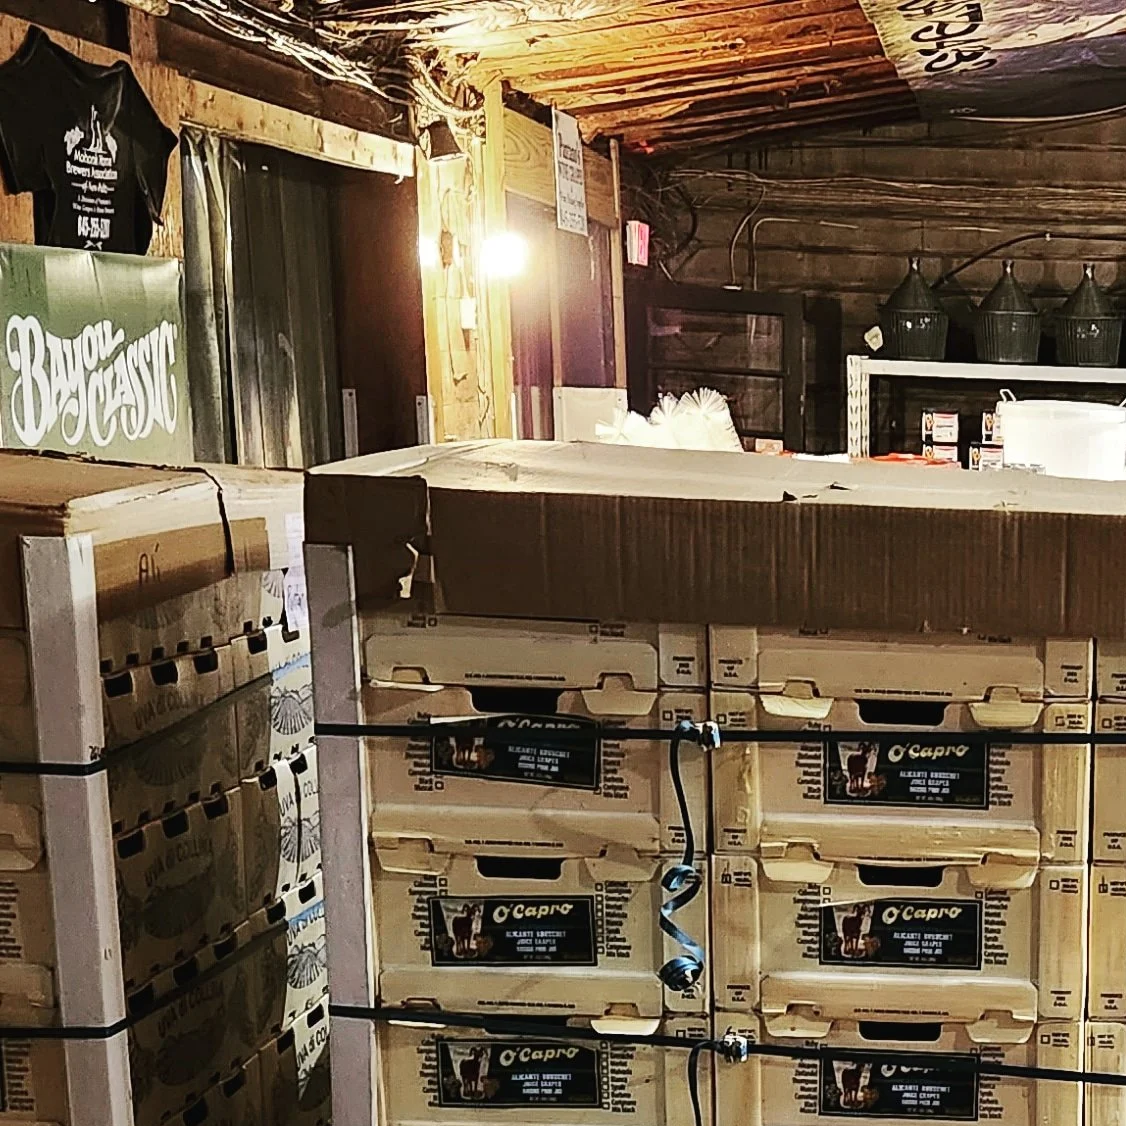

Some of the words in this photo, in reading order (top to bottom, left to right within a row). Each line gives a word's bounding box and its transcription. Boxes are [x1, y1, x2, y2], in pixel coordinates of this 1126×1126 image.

[6, 314, 125, 447] BAYOU
[87, 320, 178, 447] CLASSIC
[888, 745, 969, 763] O'Capro
[493, 904, 573, 923] O'Capro
[882, 906, 962, 924] O'Capro
[500, 1047, 579, 1066] O'Capro
